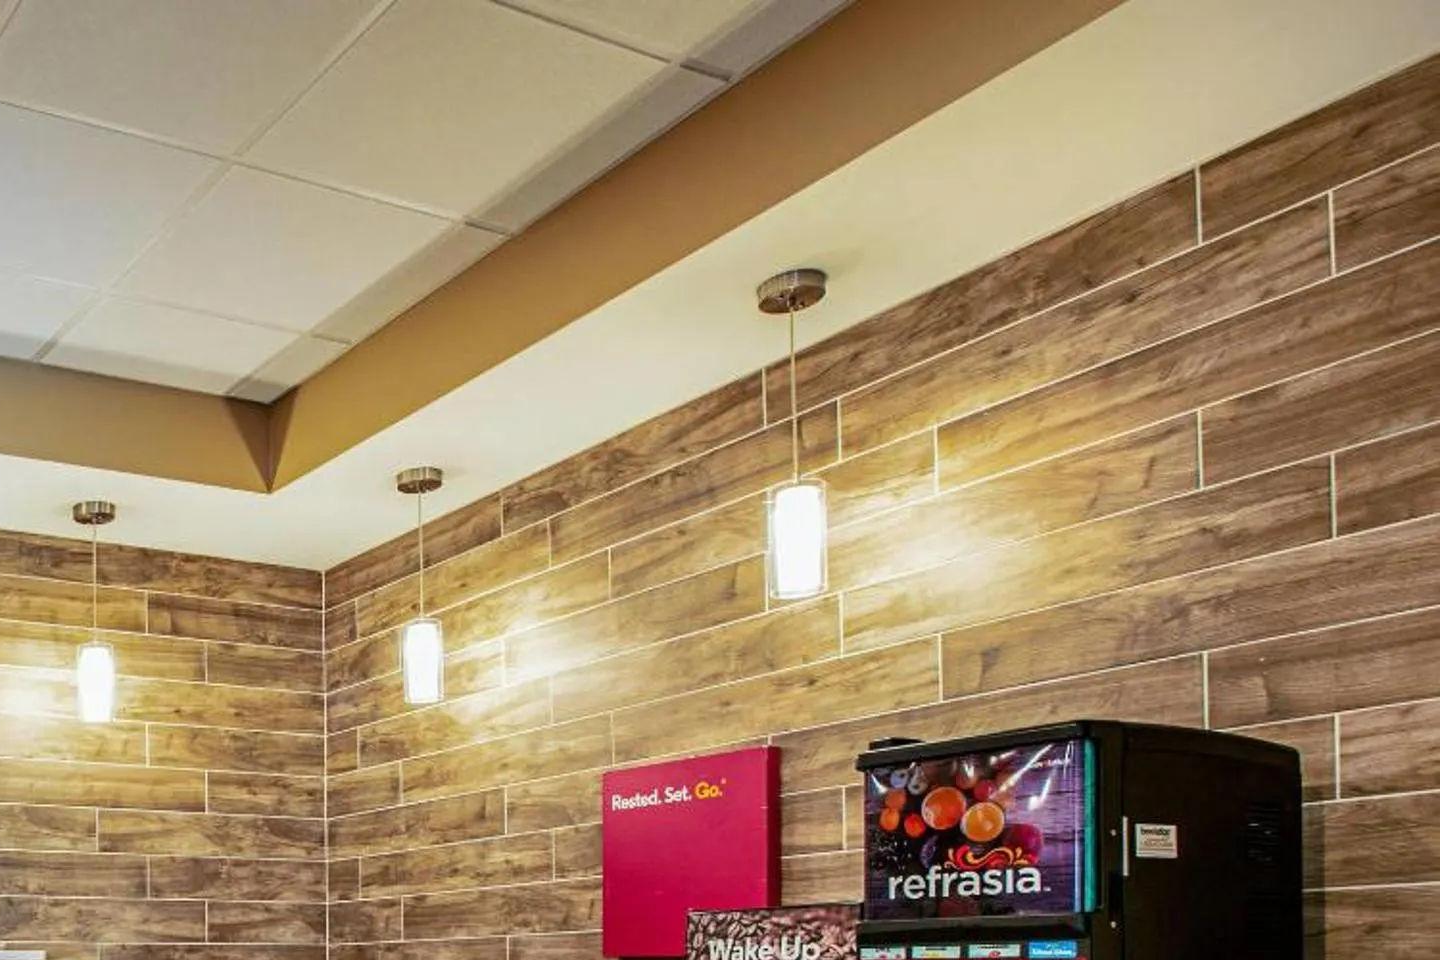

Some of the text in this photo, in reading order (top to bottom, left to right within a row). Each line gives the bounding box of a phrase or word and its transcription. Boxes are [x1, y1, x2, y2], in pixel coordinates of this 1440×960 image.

[611, 789, 662, 811] Rested.
[664, 785, 692, 803] Set.
[887, 865, 1042, 900] refrasia
